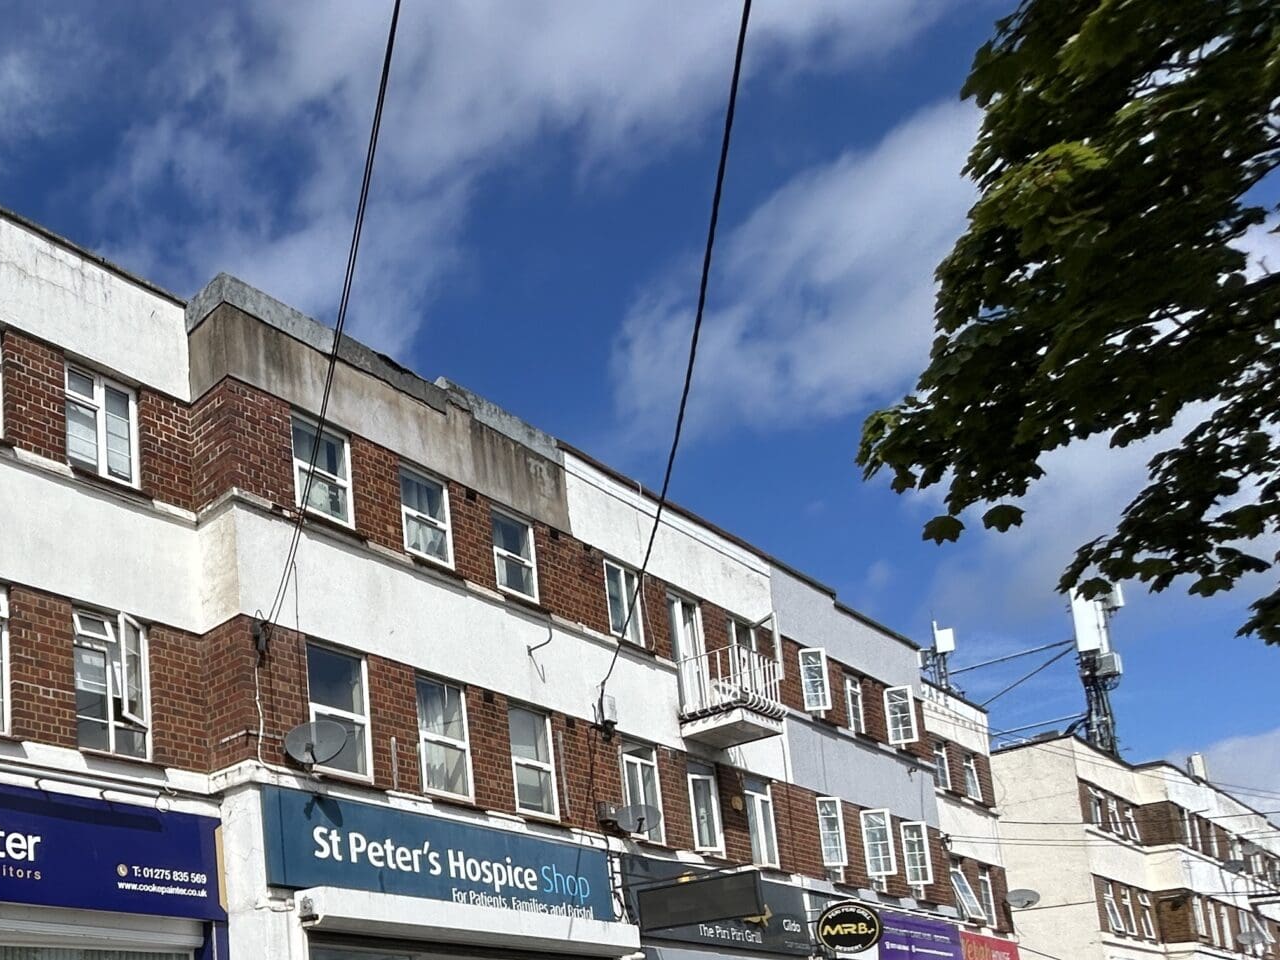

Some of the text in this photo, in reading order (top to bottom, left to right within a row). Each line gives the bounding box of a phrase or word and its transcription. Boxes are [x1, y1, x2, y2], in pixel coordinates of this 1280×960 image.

[132, 865, 207, 884] T: 01275 835 569
[312, 826, 590, 903] St Peter's Hospice Shop
[117, 882, 207, 898] www.cookepainter.co.uk
[452, 888, 467, 902] For
[512, 897, 548, 913] Families
[549, 902, 566, 916] and
[568, 905, 594, 920] Bristol
[699, 924, 714, 938] The
[745, 930, 762, 944] Grill
